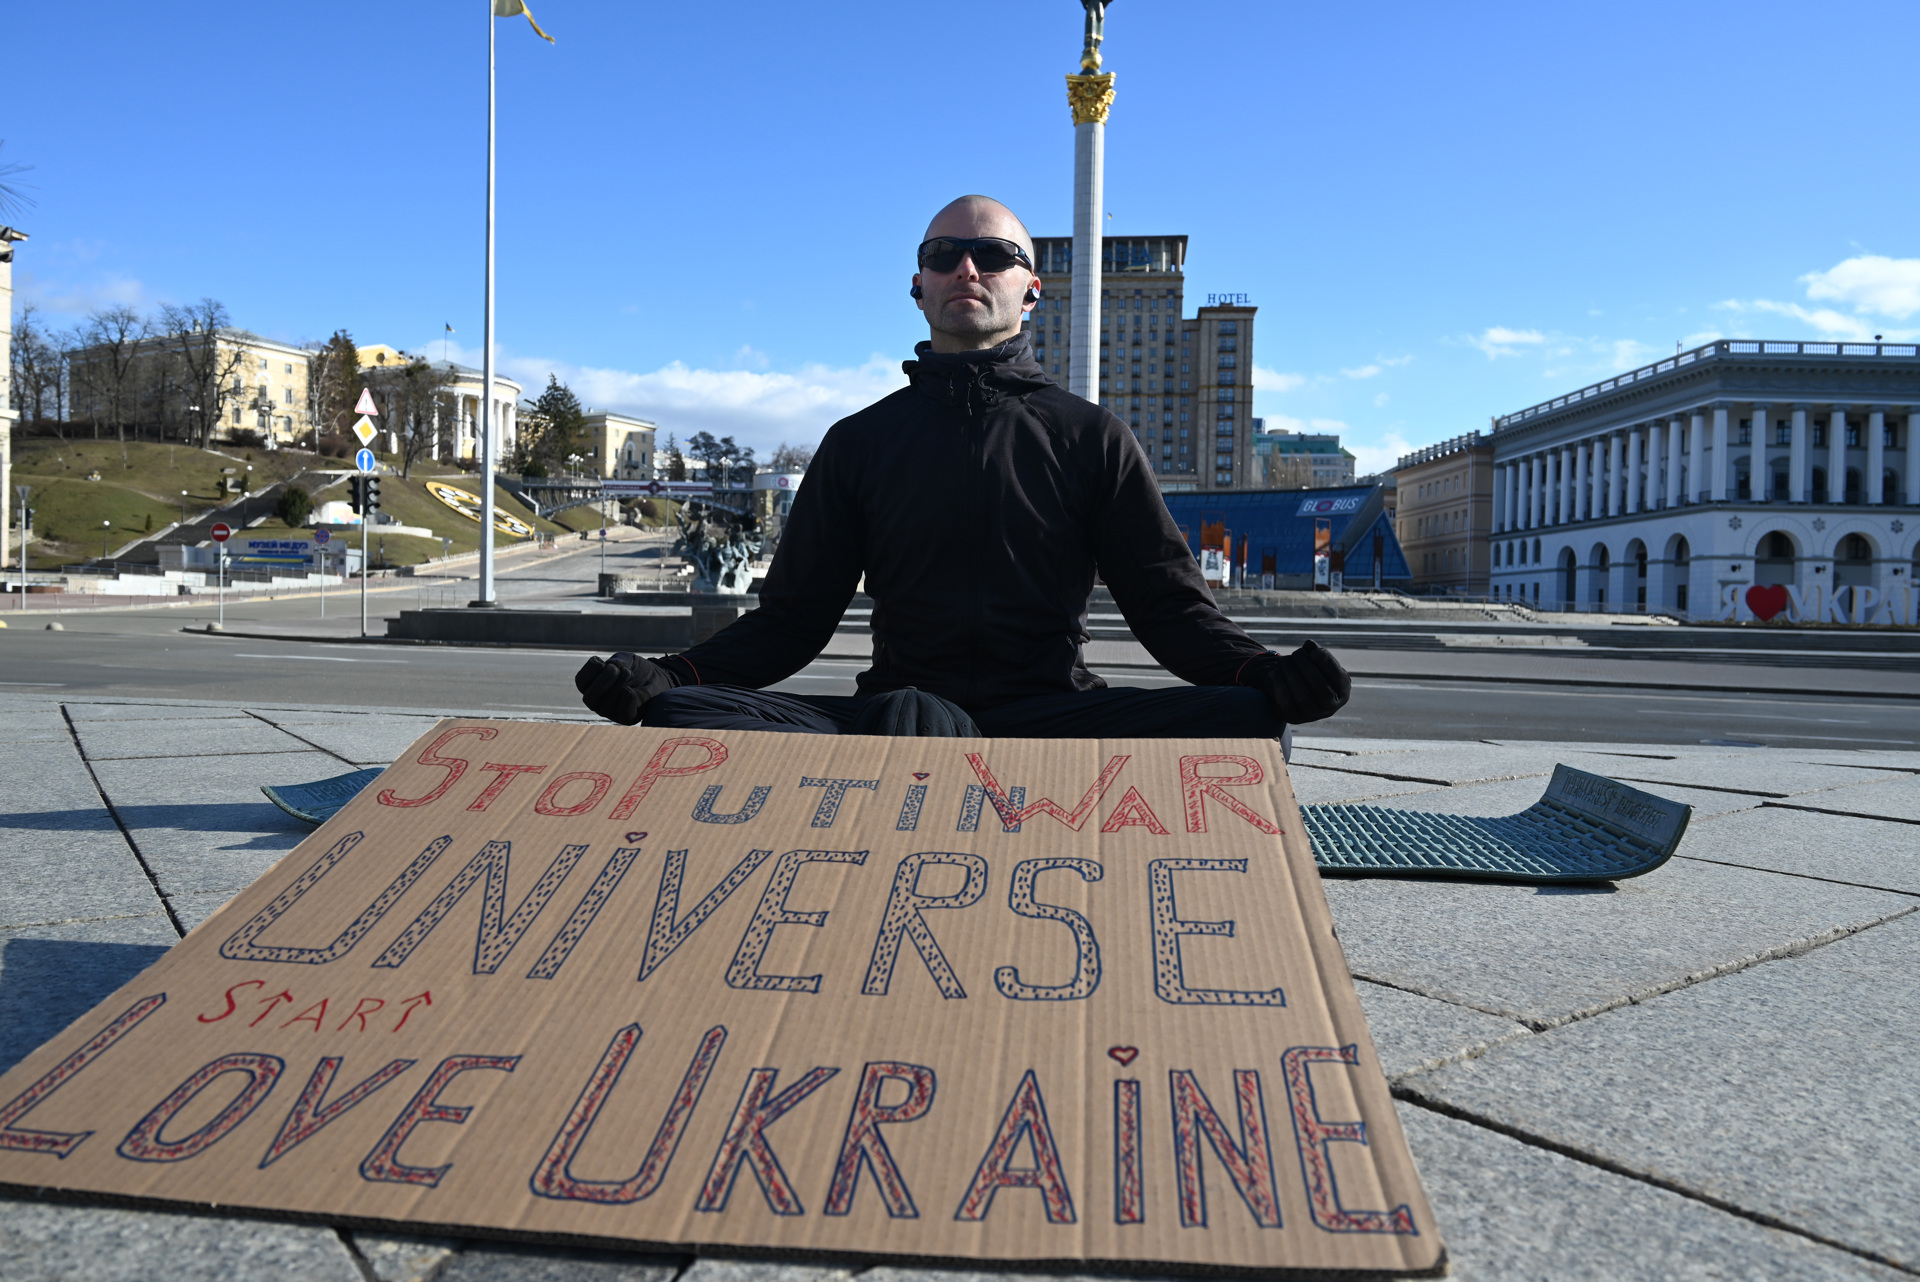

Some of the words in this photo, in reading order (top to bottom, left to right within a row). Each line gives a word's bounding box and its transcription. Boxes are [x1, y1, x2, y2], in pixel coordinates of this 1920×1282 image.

[1207, 293, 1251, 303] HOTEL
[1303, 498, 1359, 512] GLOBUS
[248, 540, 277, 549] МУЗЕЙ
[279, 541, 308, 550] МЕДУЗ
[965, 752, 1286, 835] WAR
[197, 979, 432, 1033] START
[0, 992, 523, 1188] LOVE
